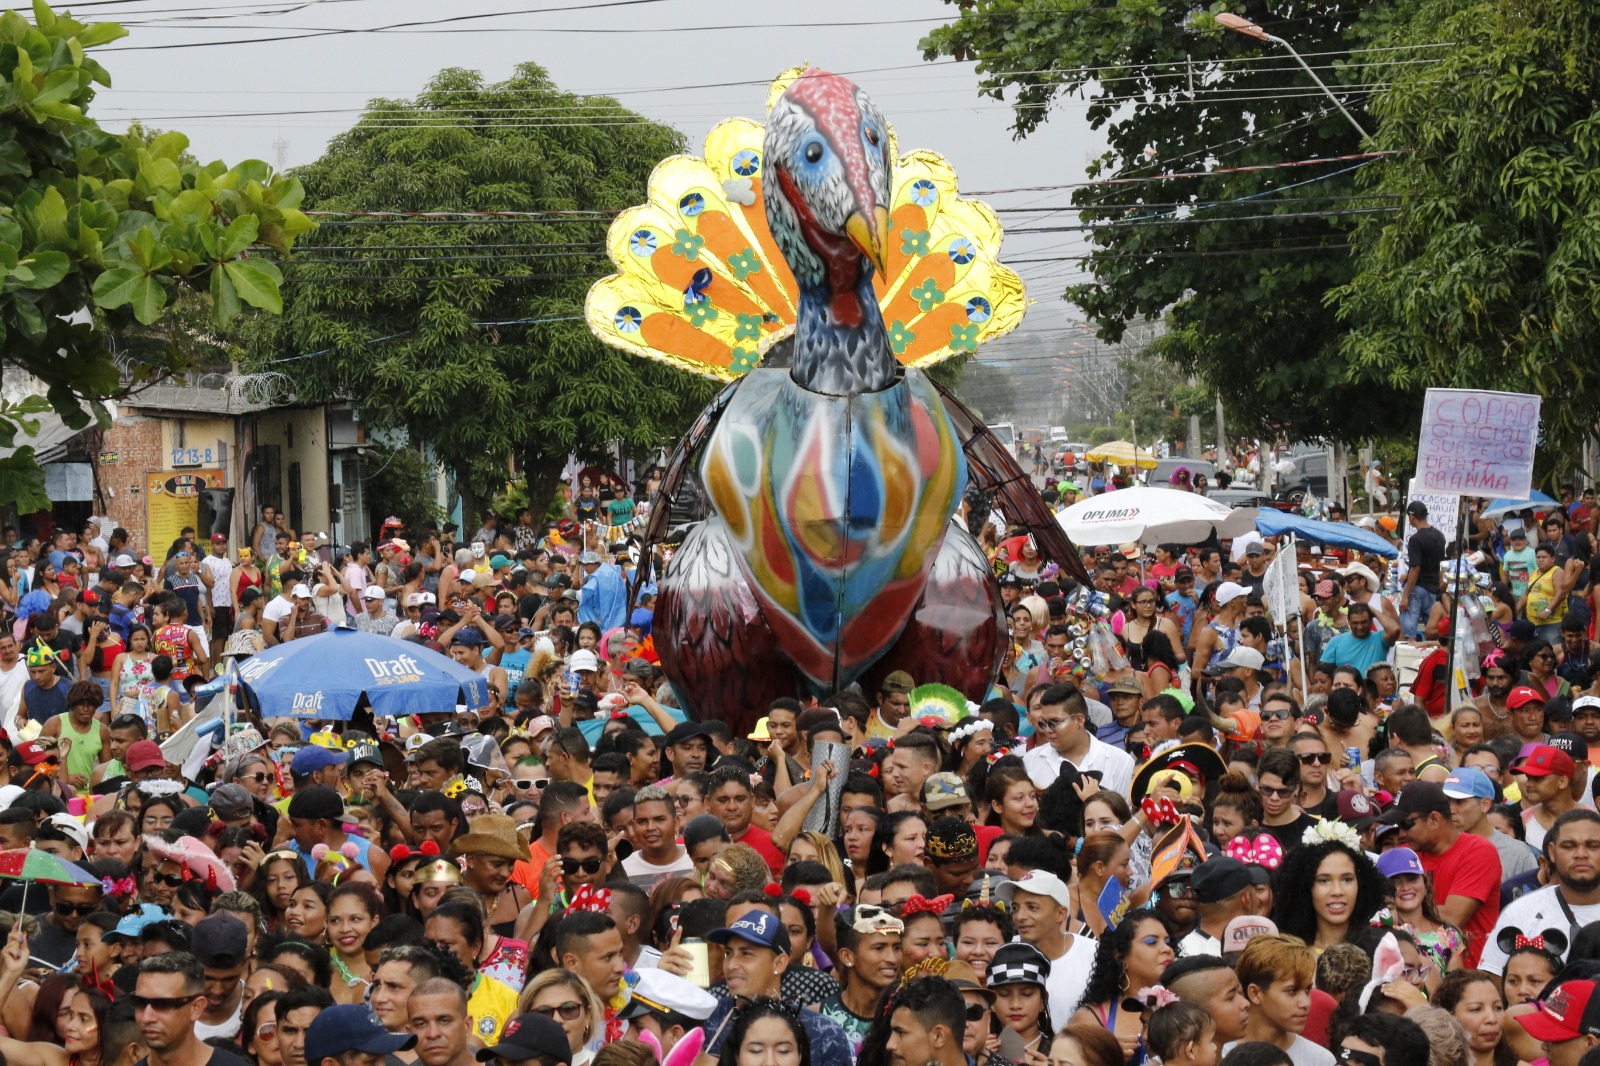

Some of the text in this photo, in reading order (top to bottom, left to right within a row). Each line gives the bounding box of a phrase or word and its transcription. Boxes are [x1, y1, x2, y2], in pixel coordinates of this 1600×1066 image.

[1431, 423, 1526, 444] GLACIAL
[1425, 455, 1501, 474] DRAFT
[1082, 508, 1130, 521] OPLIMA
[364, 654, 426, 678] Draft
[292, 690, 325, 710] Draft
[352, 744, 374, 761] 1KILO
